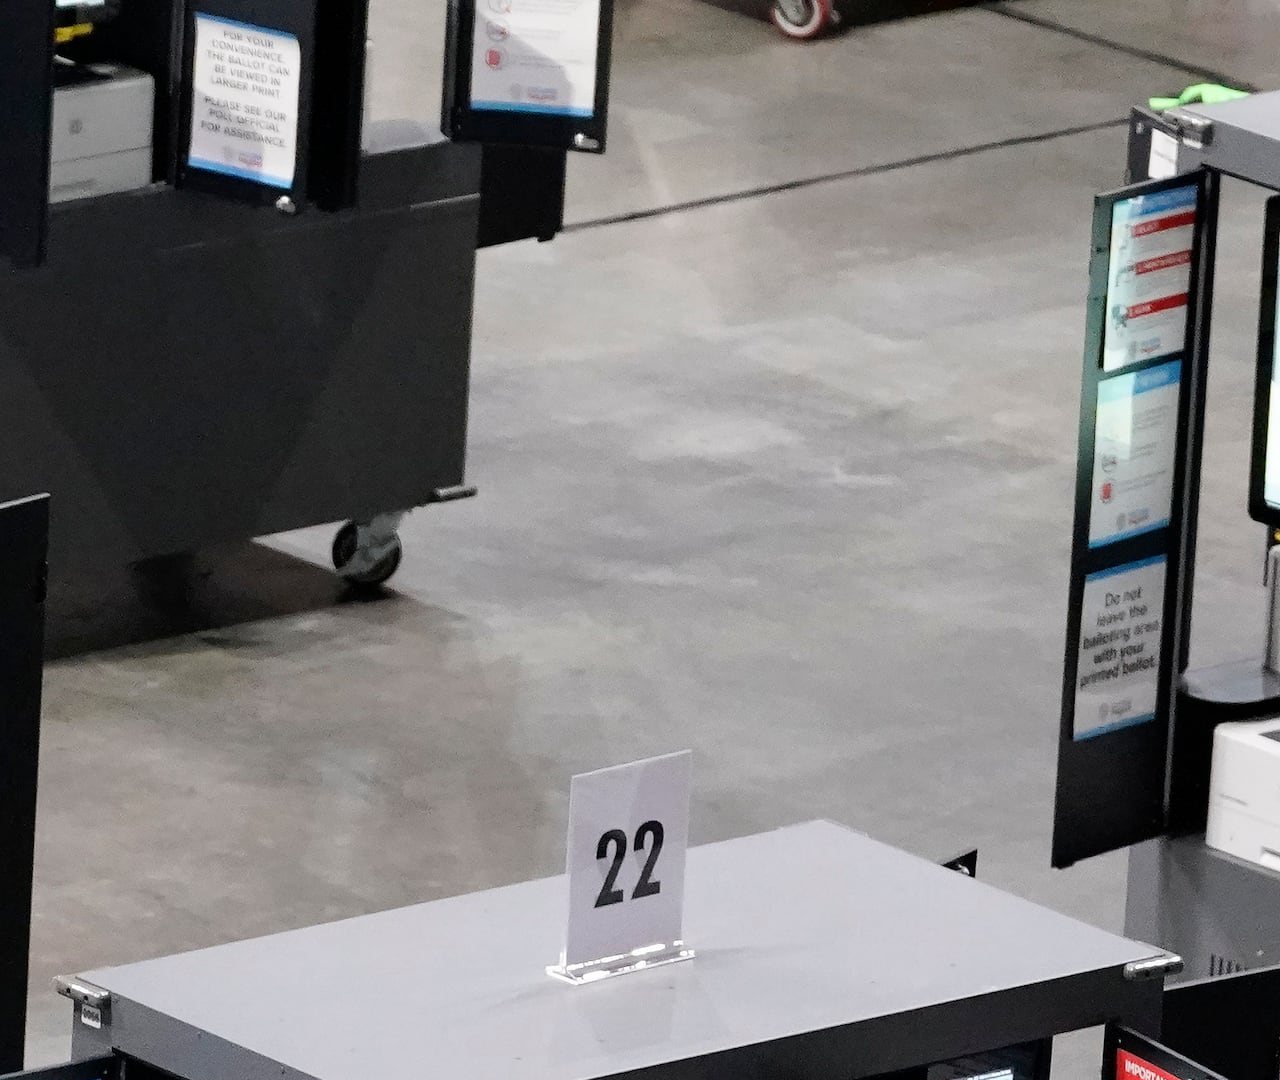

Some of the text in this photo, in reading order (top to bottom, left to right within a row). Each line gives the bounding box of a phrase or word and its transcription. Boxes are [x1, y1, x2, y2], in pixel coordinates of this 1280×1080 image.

[223, 31, 274, 48] FOR YOUR
[228, 55, 266, 71] BALLOT
[268, 65, 290, 77] CAN
[211, 78, 248, 92] LARGER
[230, 69, 268, 83] VIEWED
[271, 77, 281, 87] IN
[204, 96, 287, 121] PLEASE SEE OUR
[237, 115, 280, 133] OFFICIAL
[594, 820, 664, 908] 22
